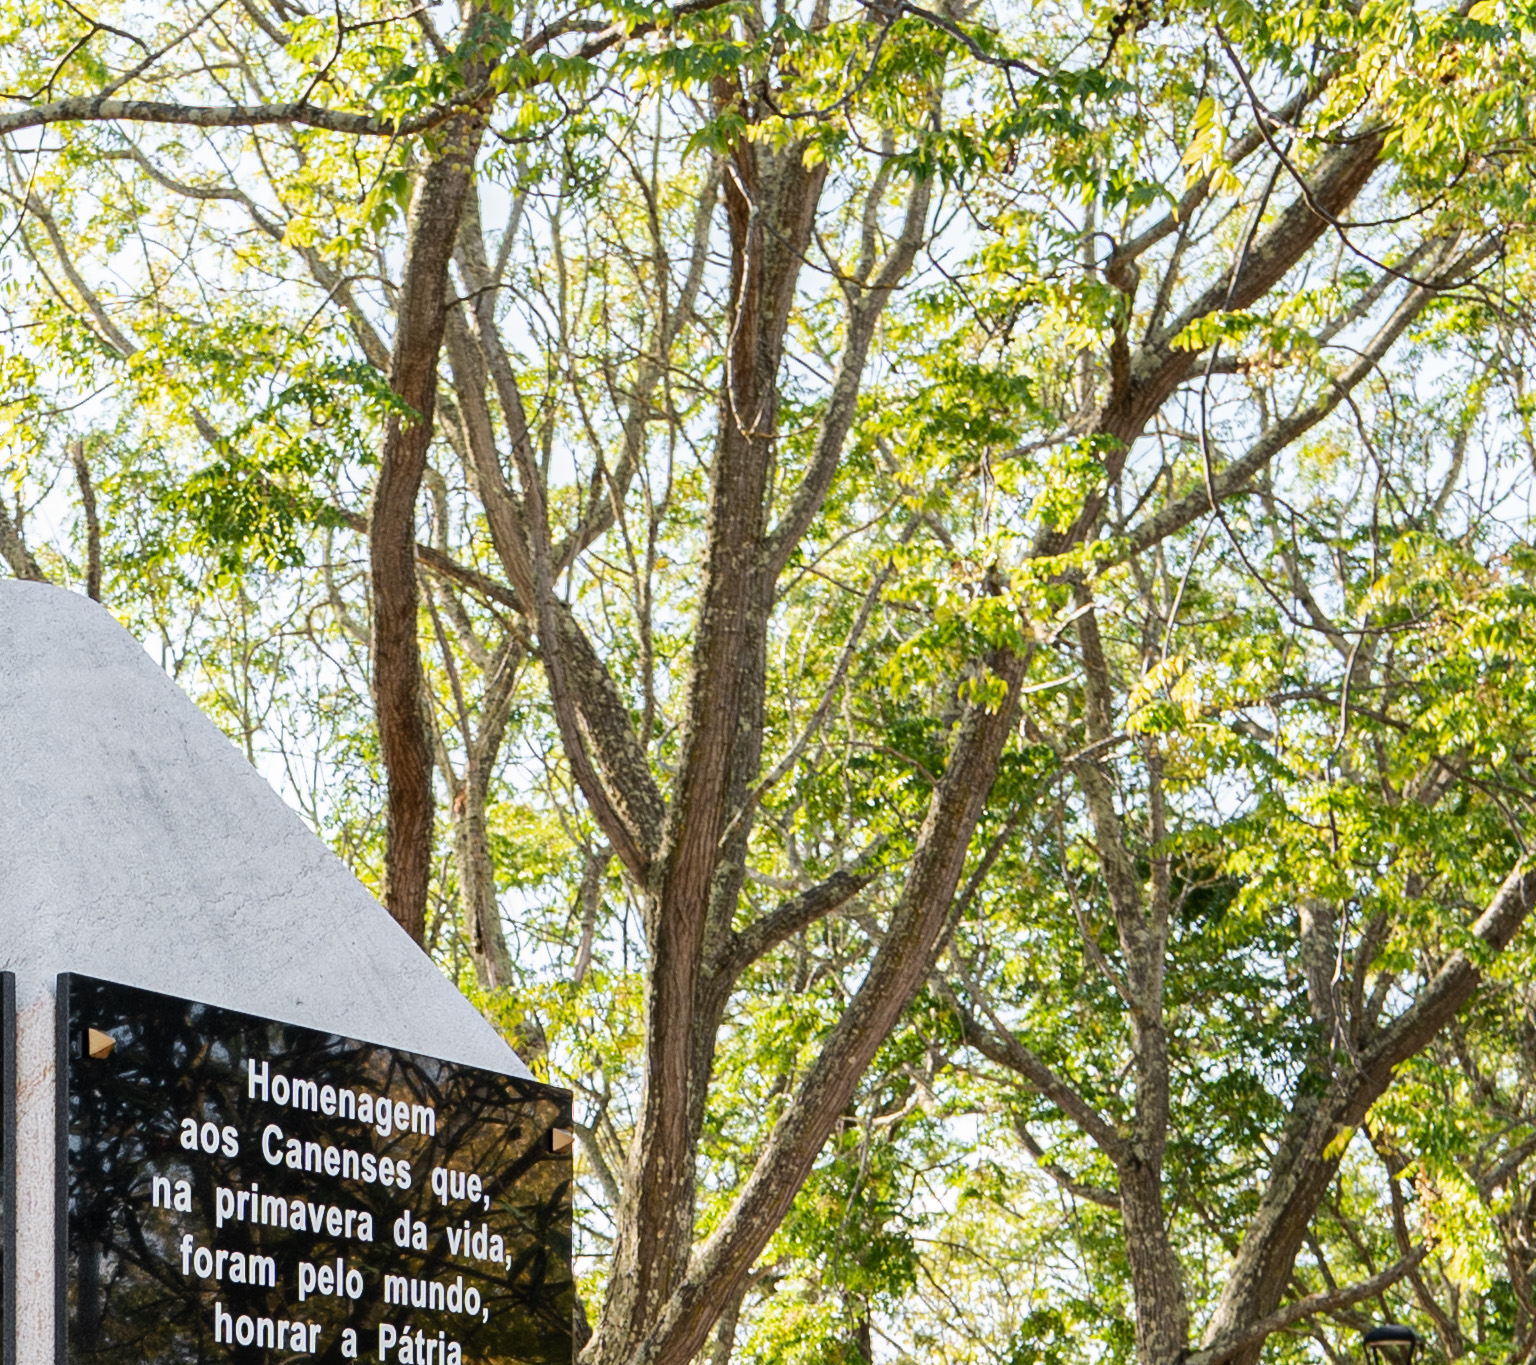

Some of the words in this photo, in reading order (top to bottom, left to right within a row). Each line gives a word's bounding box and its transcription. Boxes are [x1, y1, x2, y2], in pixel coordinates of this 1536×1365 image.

[249, 1059, 435, 1136] Homenagem
[181, 1118, 238, 1157] aos
[262, 1124, 411, 1189] Canenses
[432, 1167, 489, 1211] que,
[153, 1176, 191, 1212] na
[216, 1183, 373, 1241] primavera
[394, 1210, 427, 1250] da
[447, 1221, 511, 1271] vida,
[180, 1234, 275, 1286] foram
[299, 1258, 363, 1301] pelo
[385, 1275, 488, 1323] mundo,
[215, 1302, 321, 1353] honrar
[342, 1328, 357, 1358] a
